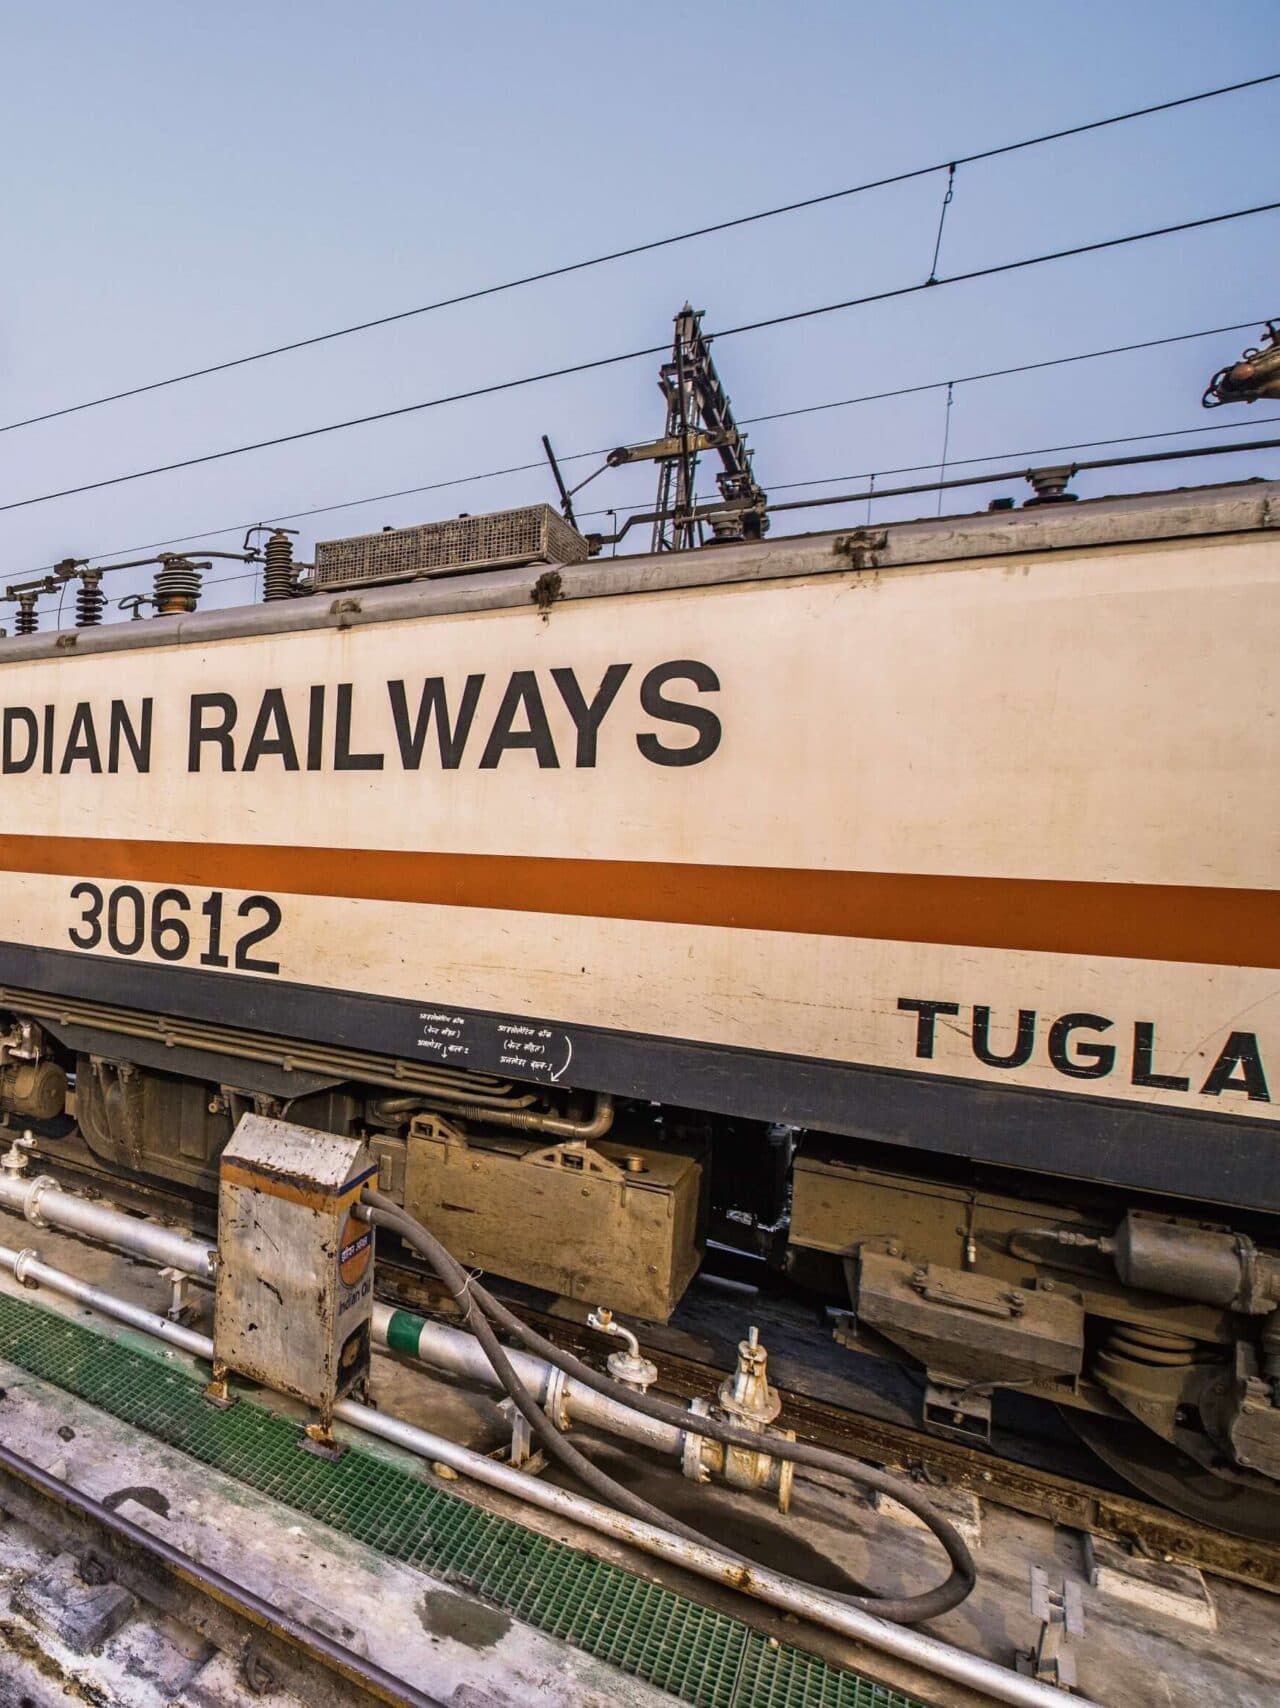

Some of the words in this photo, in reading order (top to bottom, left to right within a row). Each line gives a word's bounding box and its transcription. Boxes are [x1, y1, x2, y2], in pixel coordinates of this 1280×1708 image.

[188, 659, 722, 773] RAILWAYS
[68, 881, 282, 975] 30612
[897, 997, 1271, 1103] TUGLA
